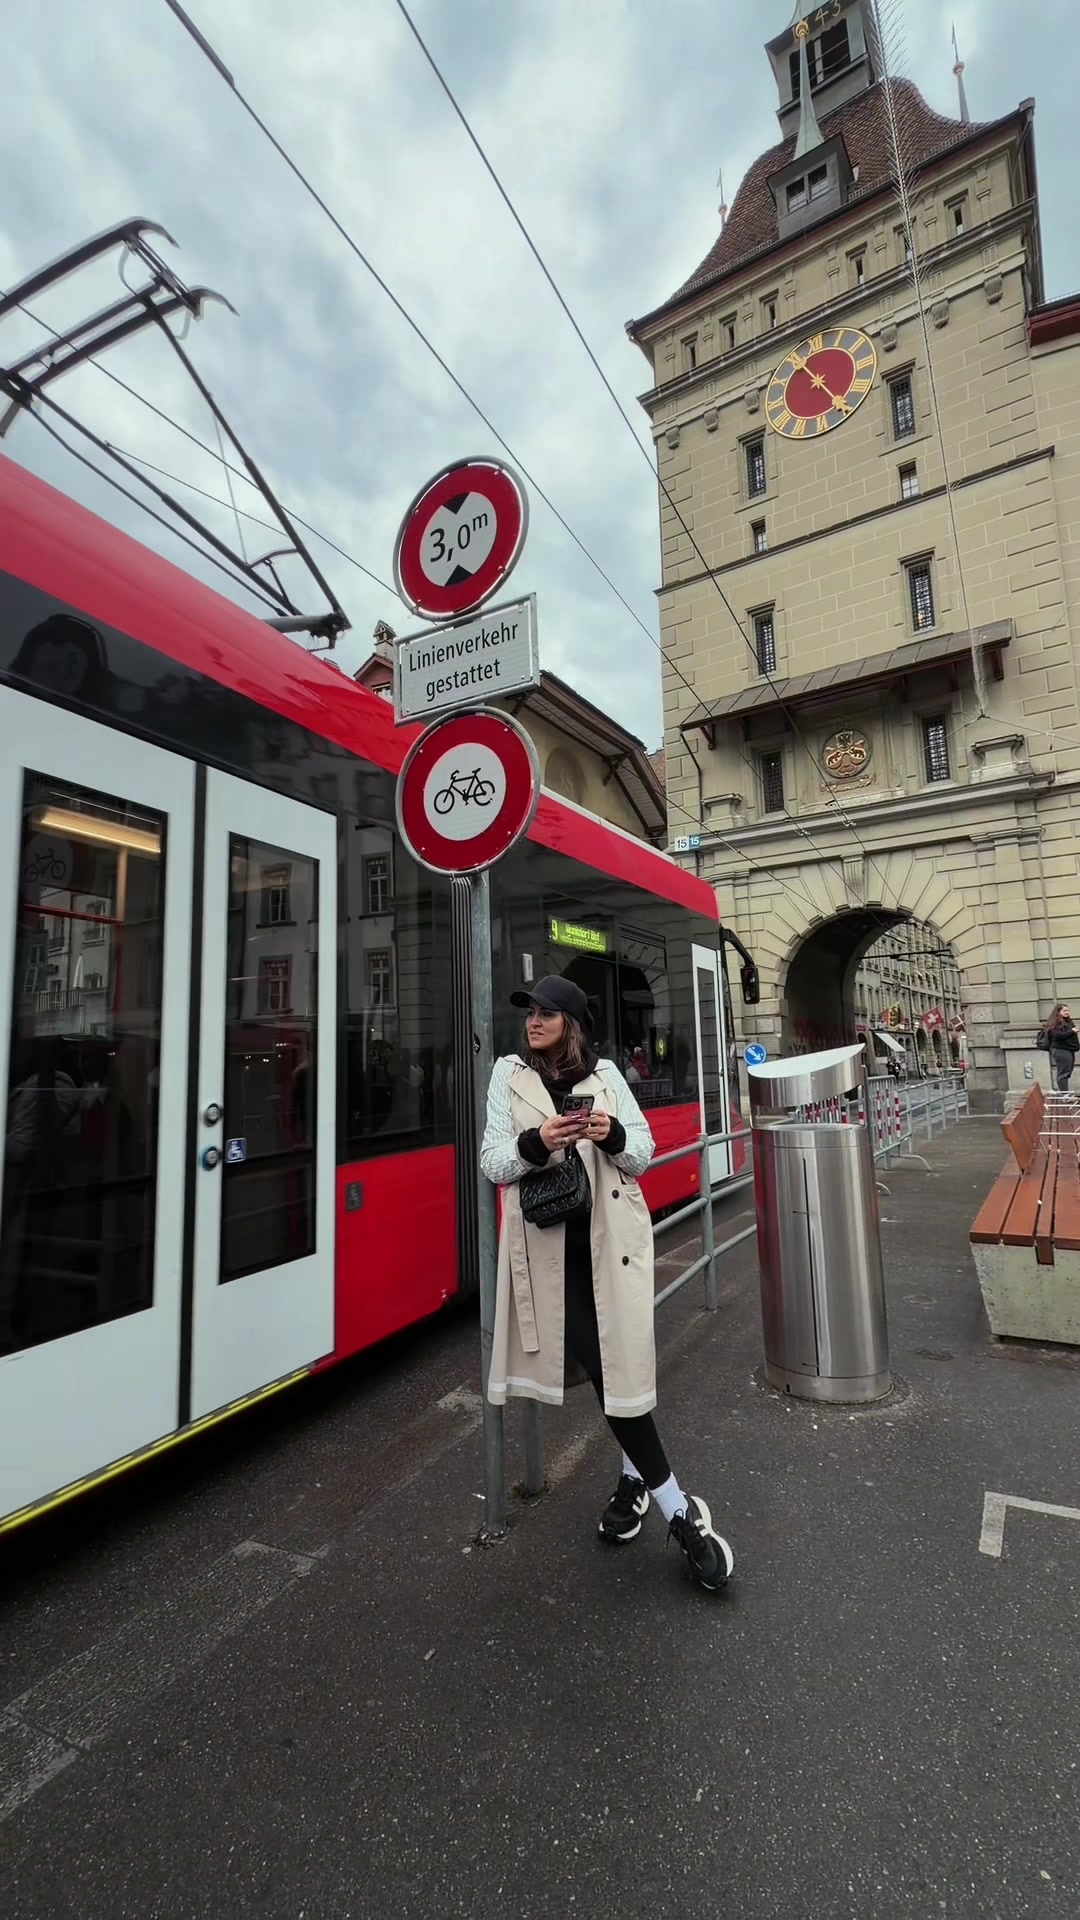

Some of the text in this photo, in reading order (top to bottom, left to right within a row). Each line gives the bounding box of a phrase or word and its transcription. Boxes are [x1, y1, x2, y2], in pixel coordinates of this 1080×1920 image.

[409, 622, 519, 672] Linienverkehr
[426, 658, 501, 702] gestattet
[677, 839, 687, 848] 15
[690, 836, 700, 845] 15
[551, 919, 558, 941] 9
[658, 1039, 664, 1056] 9
